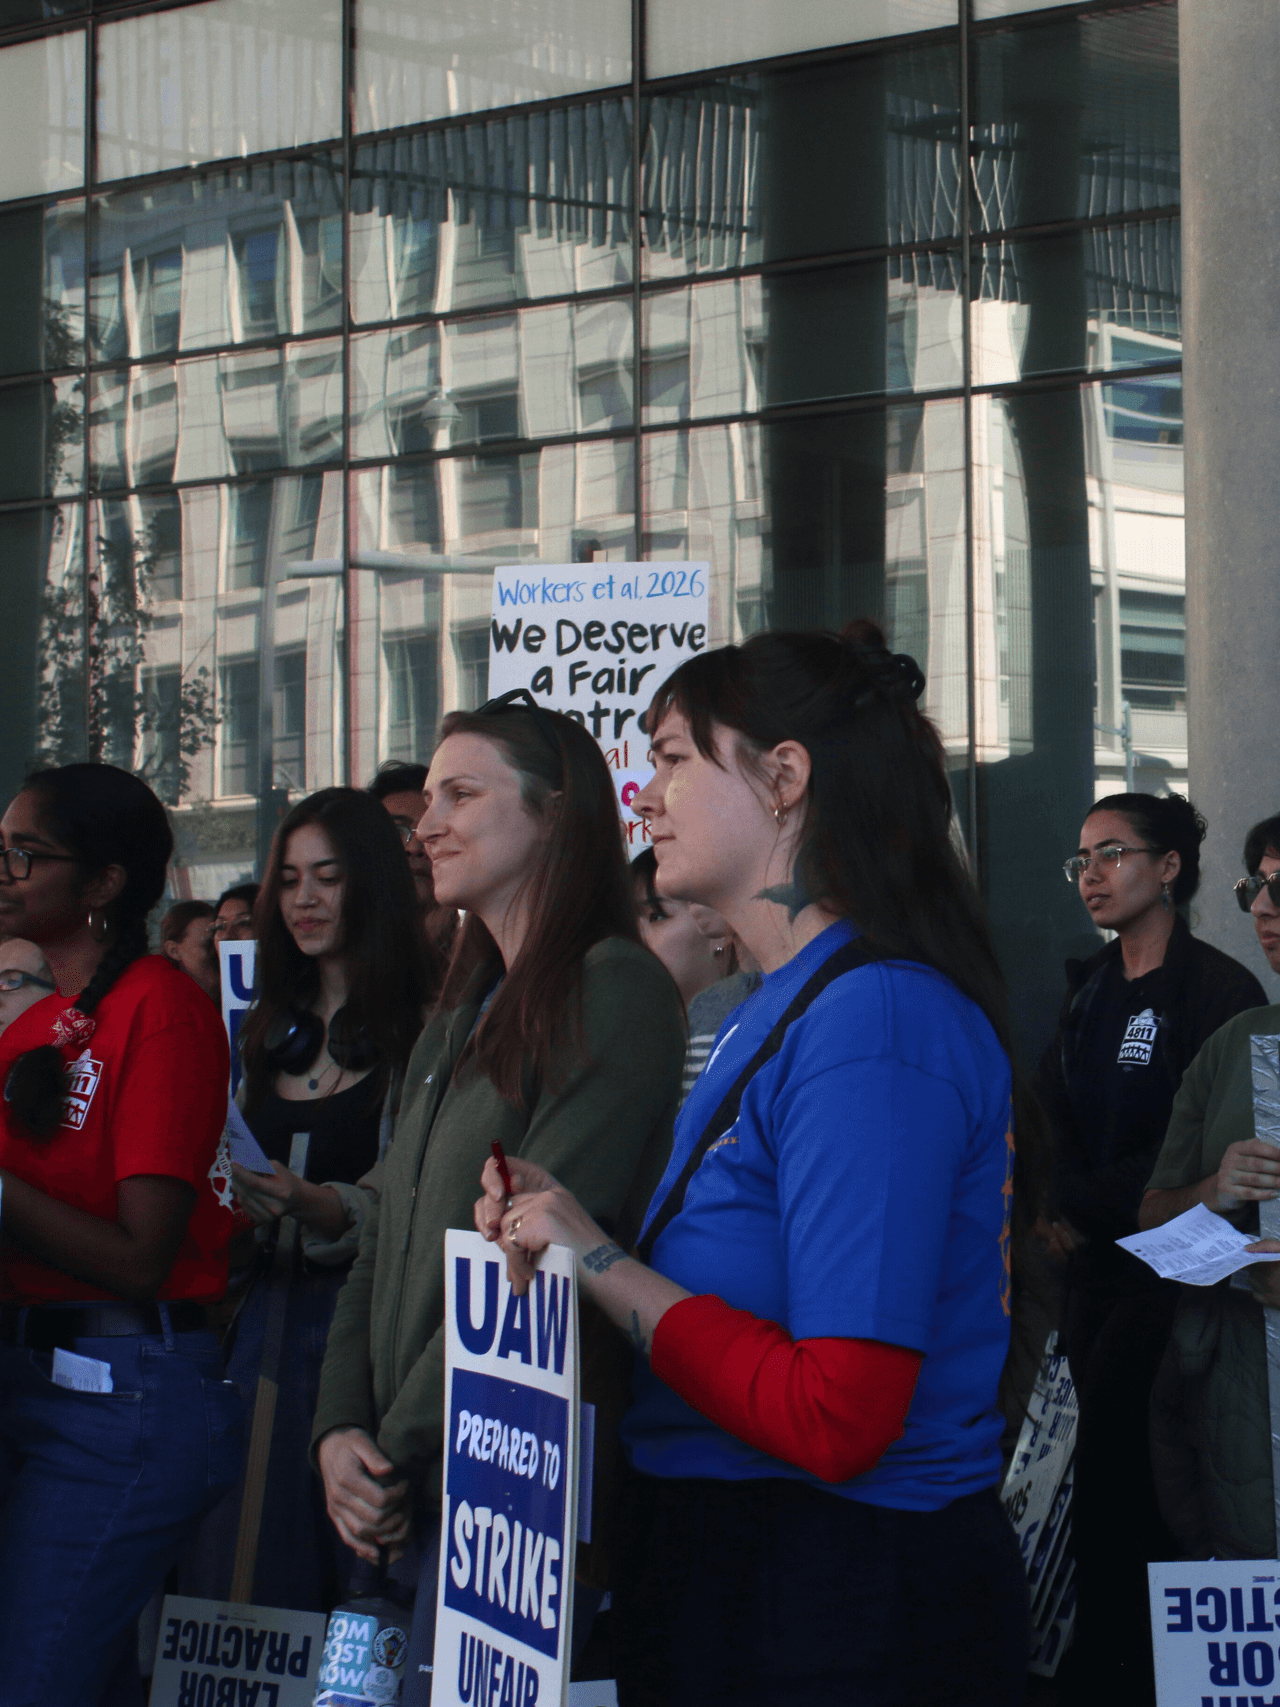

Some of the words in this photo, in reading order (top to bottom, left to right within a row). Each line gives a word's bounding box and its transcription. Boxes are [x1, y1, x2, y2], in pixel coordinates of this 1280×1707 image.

[498, 577, 587, 606] Workers
[592, 574, 616, 600] et
[646, 569, 705, 599] 2026
[491, 617, 546, 654] We
[555, 618, 706, 656] Deserve
[531, 665, 553, 696] a
[569, 658, 656, 696] Fair
[1127, 1026, 1154, 1039] 4811
[455, 1256, 570, 1376] UAW
[456, 1409, 538, 1480] PREPARED
[543, 1439, 561, 1491] TO
[451, 1500, 561, 1630] STRIKE
[162, 1617, 312, 1678] PRACTICE
[458, 1631, 540, 1707] UNFAIR
[177, 1670, 280, 1707] LABOR
